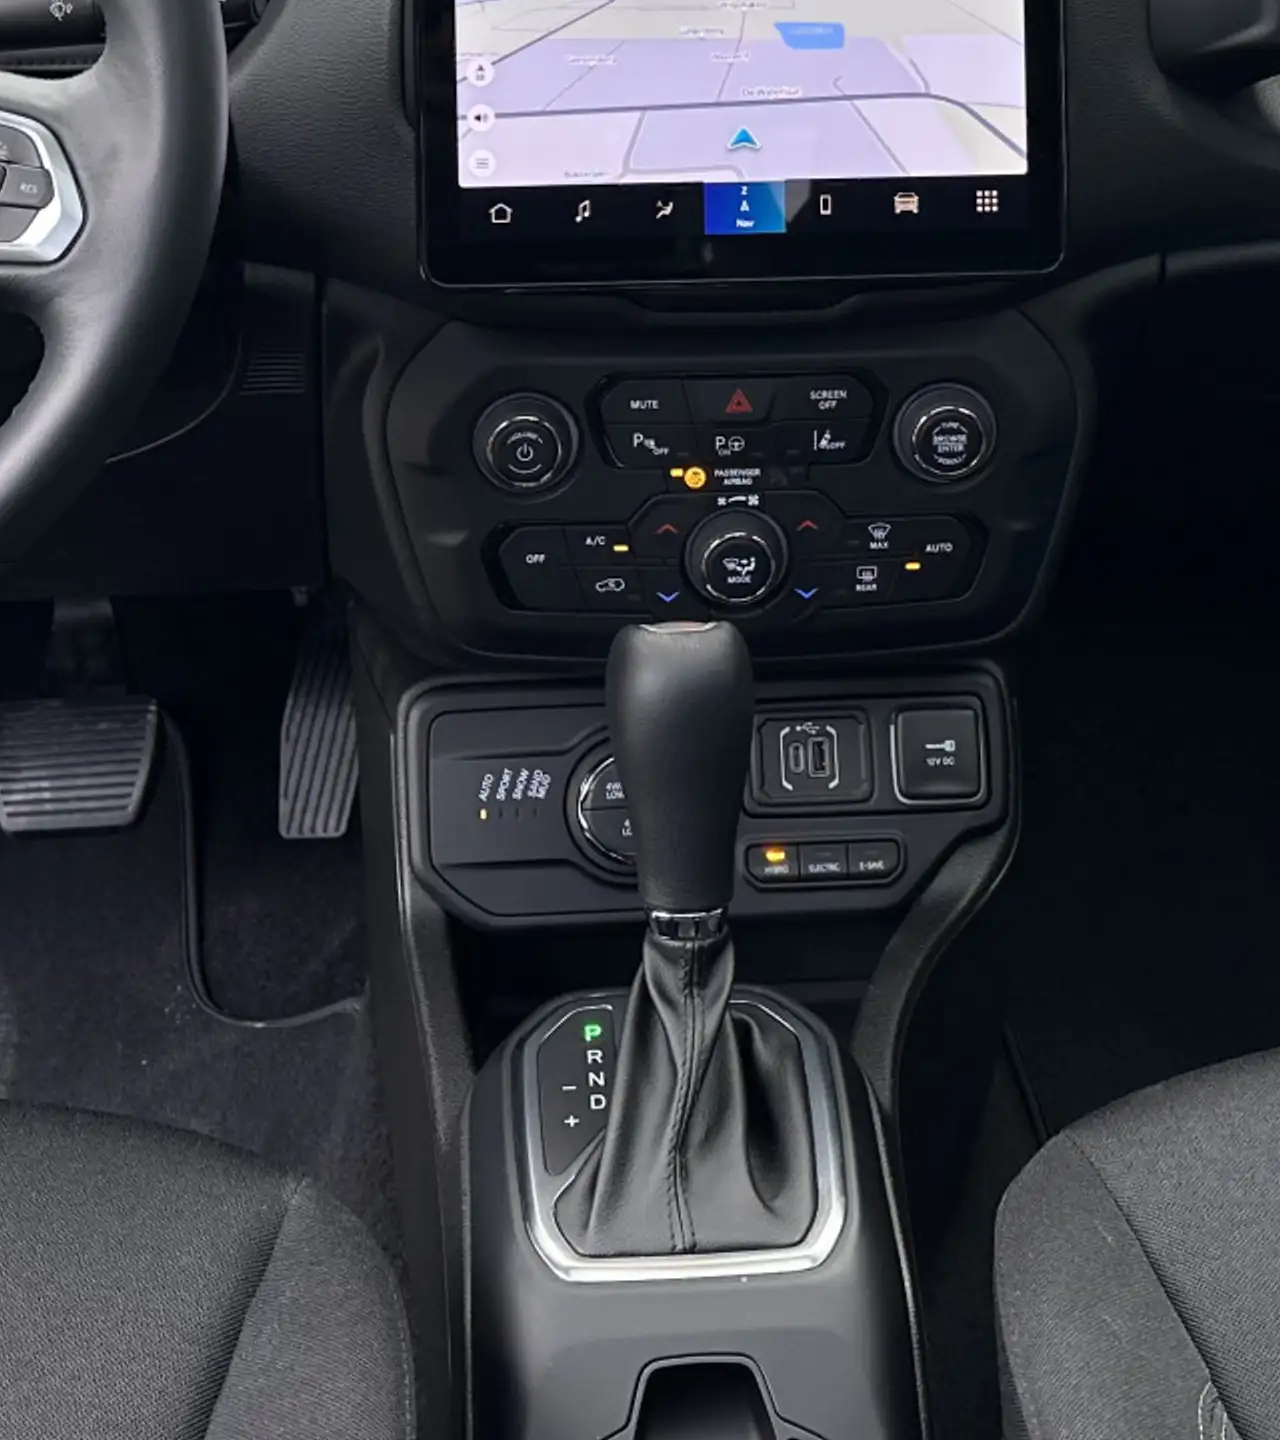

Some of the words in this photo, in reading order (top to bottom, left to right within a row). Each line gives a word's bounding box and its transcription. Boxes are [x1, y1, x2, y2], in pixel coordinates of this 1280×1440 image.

[809, 389, 848, 400] SCREEN
[630, 400, 659, 410] MUTE
[817, 400, 838, 410] OFF
[633, 433, 644, 448] P
[715, 436, 726, 450] P
[714, 467, 761, 478] PASSENGER
[584, 535, 606, 546] A/C
[869, 540, 889, 550] MAX
[924, 542, 954, 553] AUTO
[525, 554, 546, 564] OFF
[726, 576, 752, 584] MODE
[478, 773, 495, 802] AUTO
[495, 767, 513, 801] SPORT
[511, 767, 530, 801] SNOW
[584, 1023, 602, 1042] P
[586, 1049, 603, 1064] R
[588, 1071, 605, 1087] N
[590, 1093, 606, 1110] D
